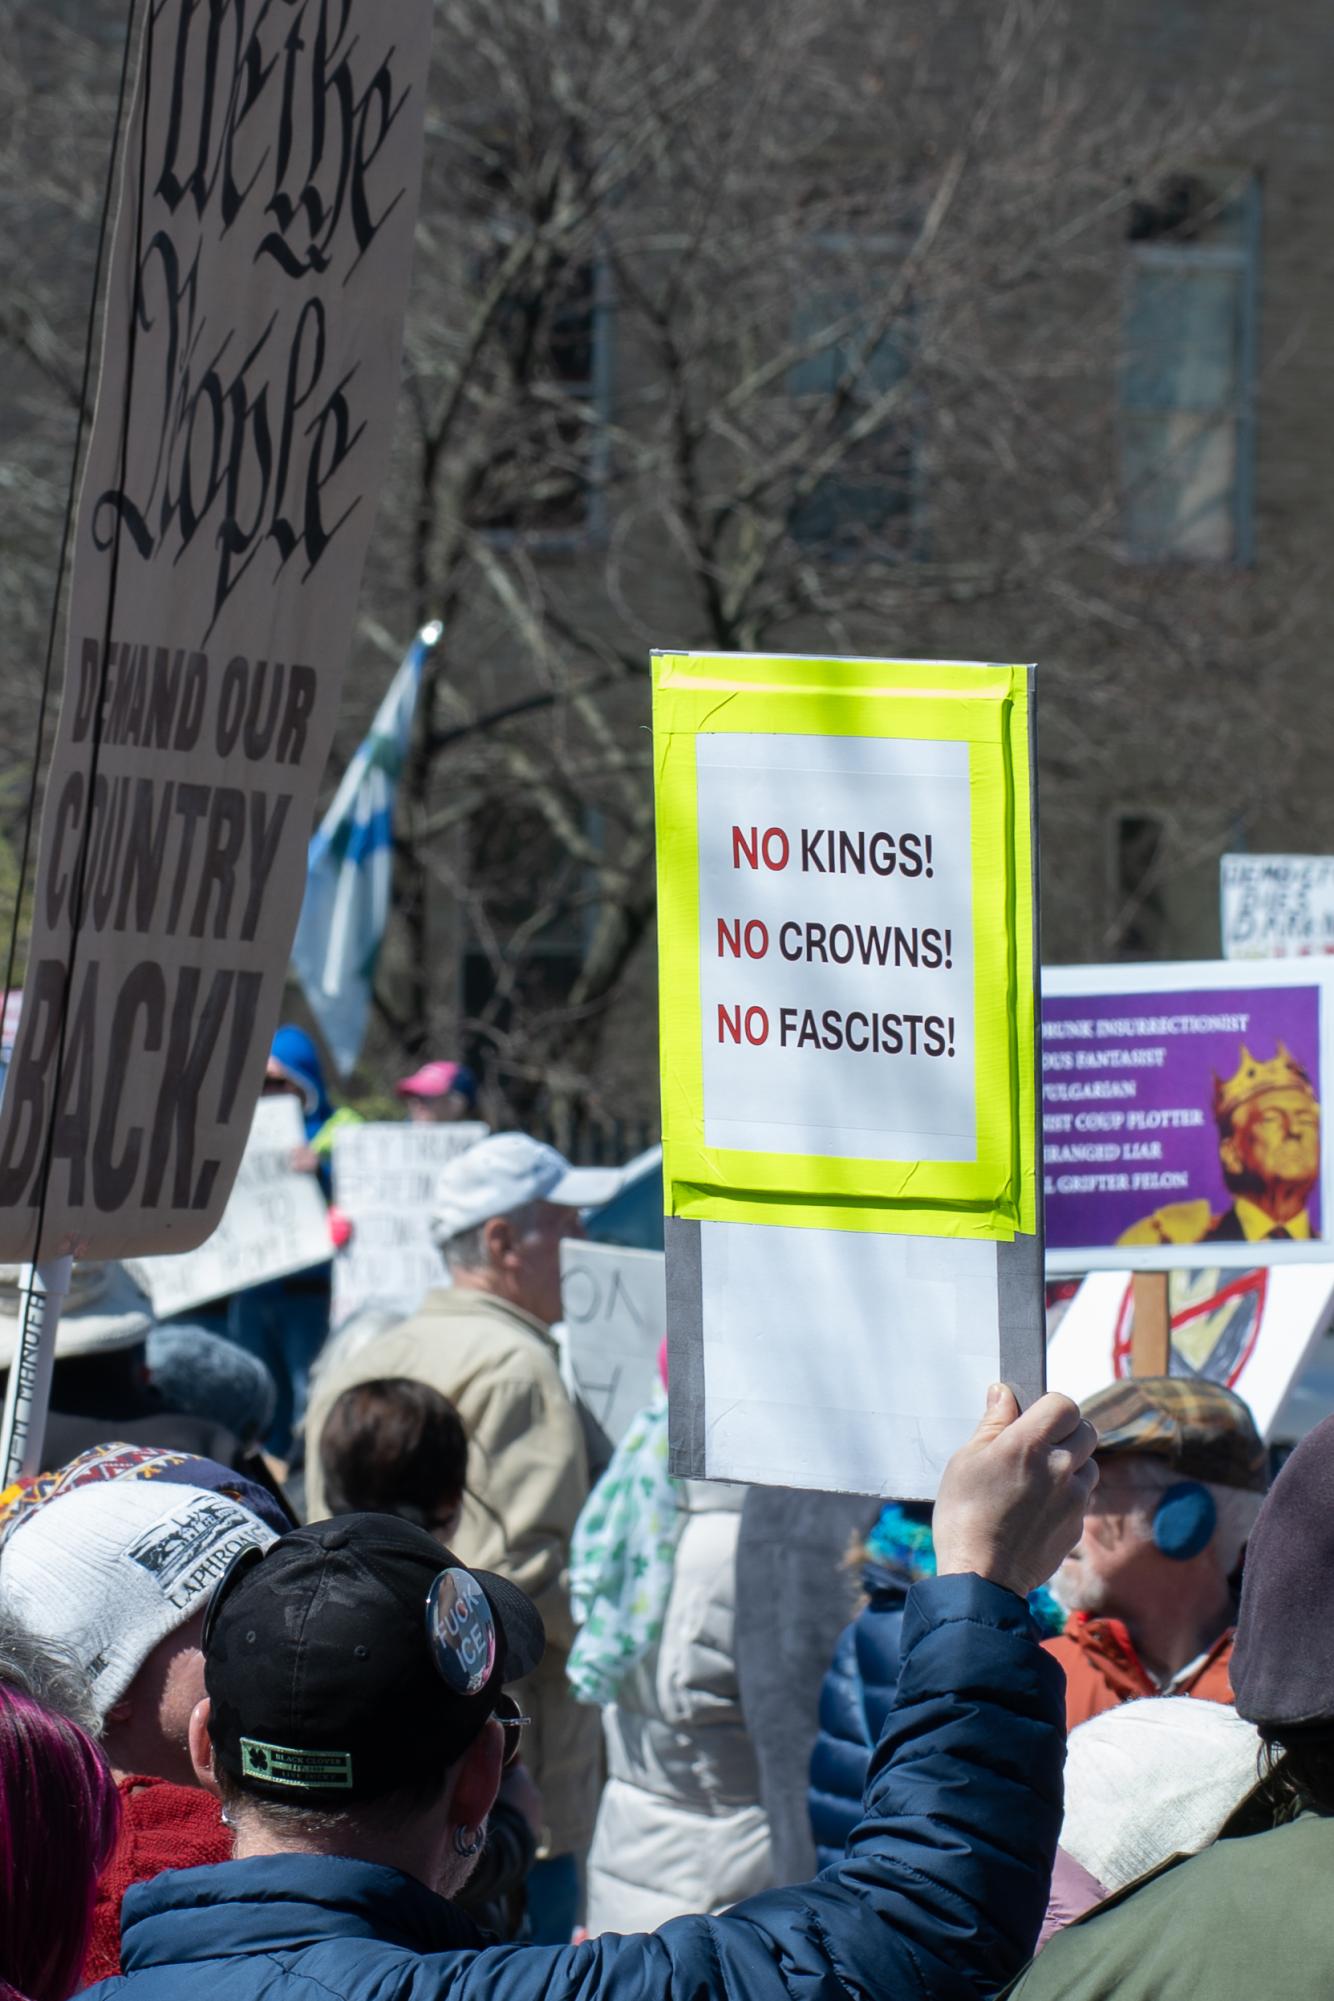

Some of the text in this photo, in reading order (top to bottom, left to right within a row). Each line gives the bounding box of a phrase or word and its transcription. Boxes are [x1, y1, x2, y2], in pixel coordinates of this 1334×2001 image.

[91, 229, 368, 650] People
[72, 637, 317, 765] DEMAND OUR
[45, 770, 293, 942] COUNTRY
[731, 826, 934, 879] NO KINGS!
[716, 918, 953, 970] NO CROWNS!
[716, 1003, 956, 1058] NO FASCISTS!
[1095, 1013, 1250, 1038] INSURRECTIONIST
[1075, 1047, 1168, 1069] FANTASIST
[0, 959, 264, 1212] BACK!
[1074, 1111, 1125, 1131] COUP
[1126, 1109, 1204, 1129] PLOTTER
[1122, 1140, 1162, 1160] LIAR
[1056, 1173, 1130, 1194] GRIFTER
[1131, 1171, 1189, 1190] FELON
[436, 1583, 479, 1649] FUCK
[456, 1622, 487, 1673] ICE
